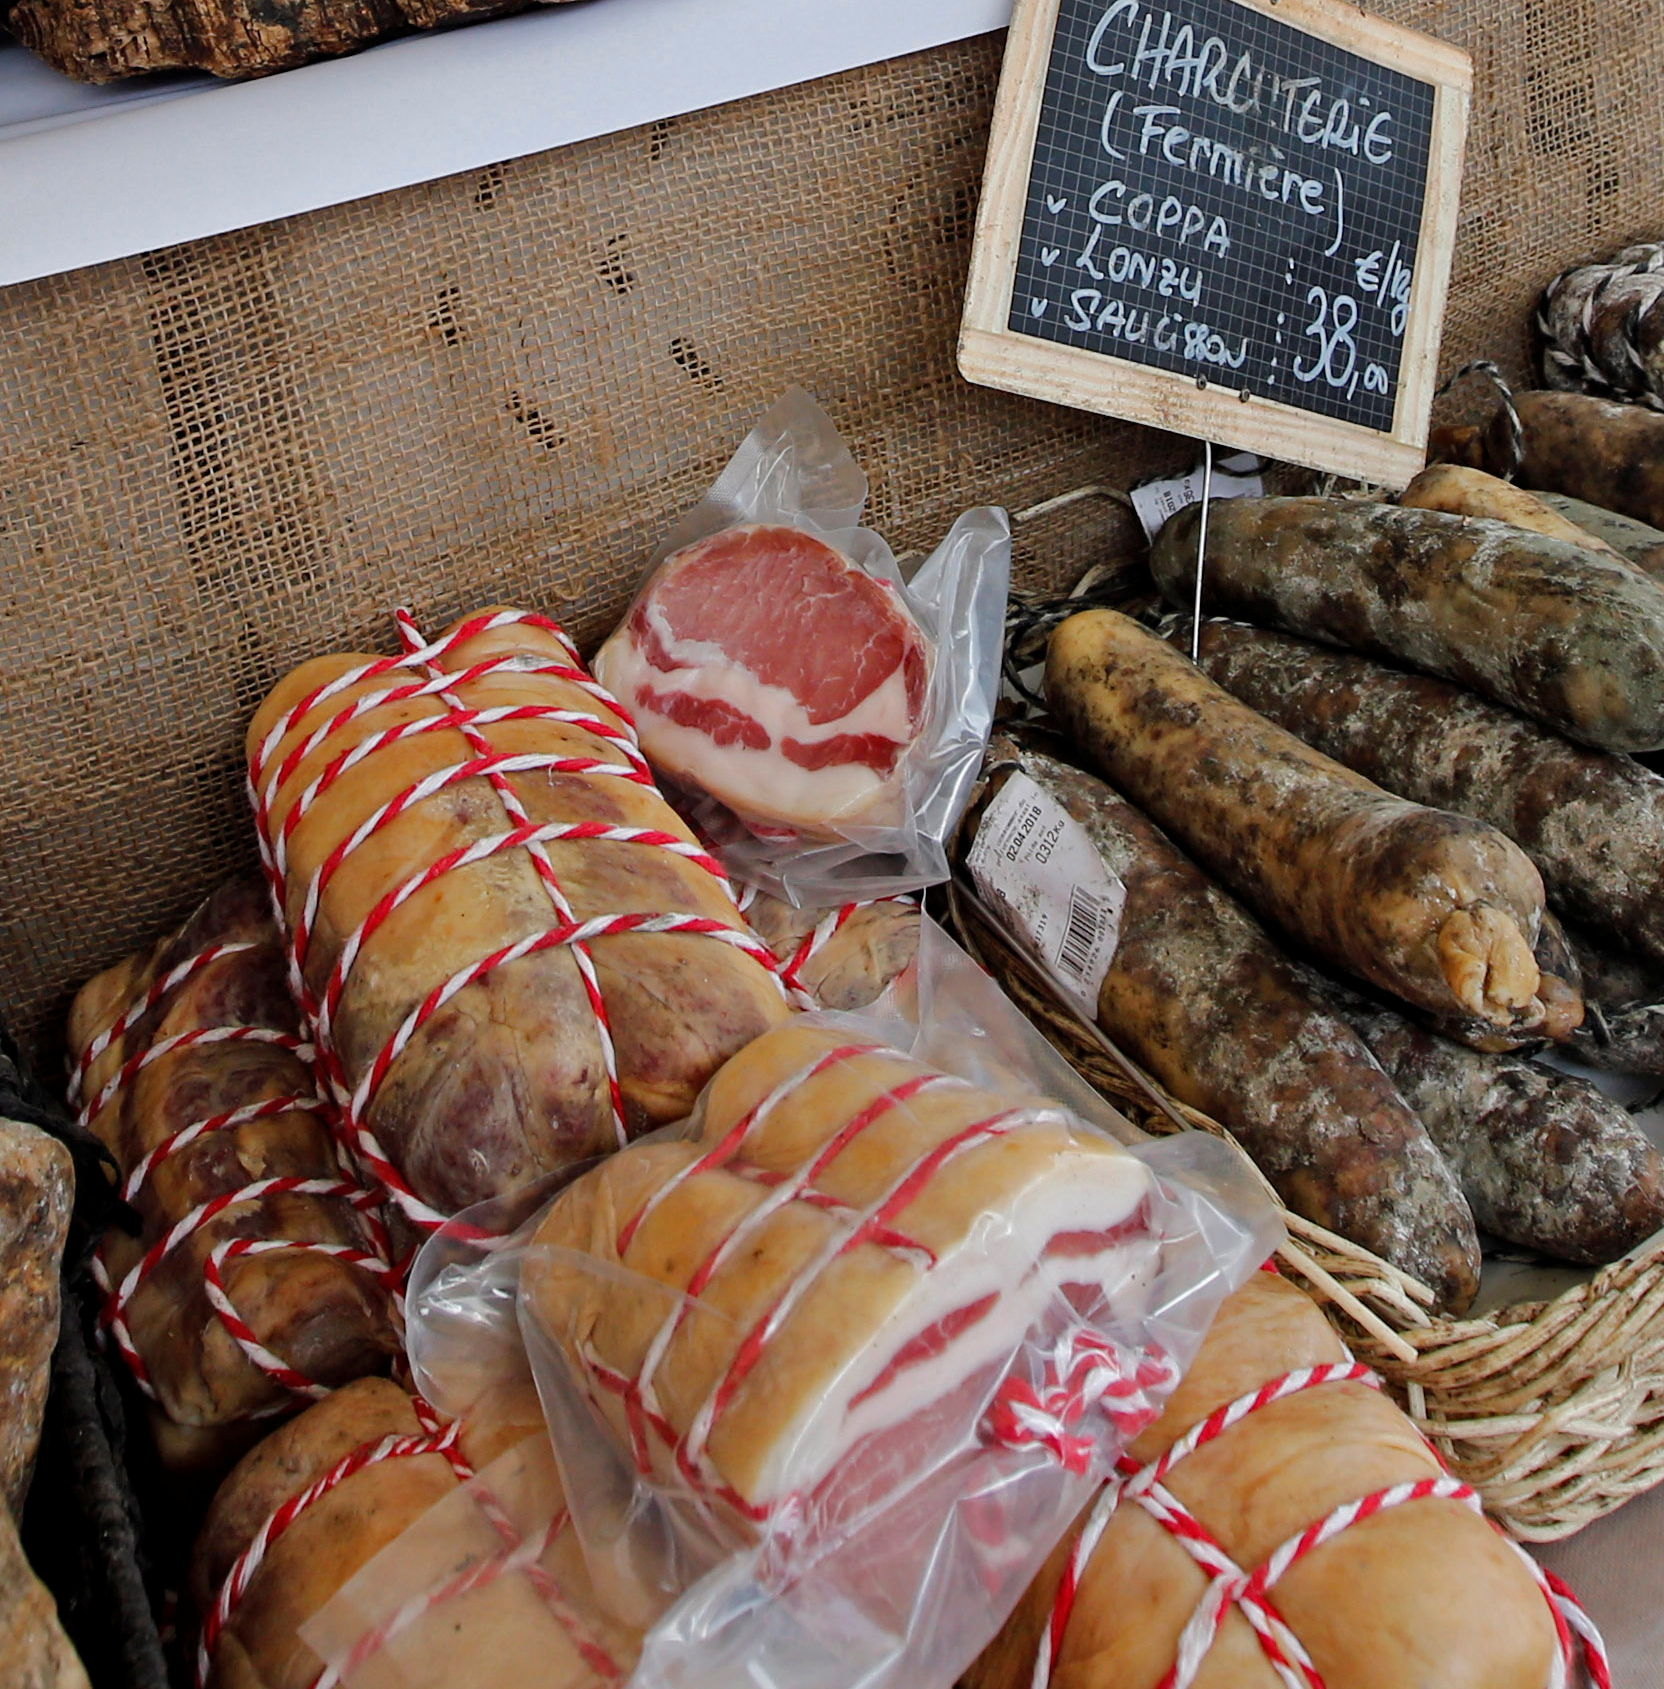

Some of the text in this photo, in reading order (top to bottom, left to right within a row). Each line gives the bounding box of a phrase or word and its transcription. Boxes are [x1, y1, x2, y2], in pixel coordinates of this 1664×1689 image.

[1088, 180, 1230, 258] COPPA
[1075, 224, 1203, 307] LONZU
[1005, 805, 1042, 861] 02.04.2018
[1034, 913, 1049, 941] 17319
